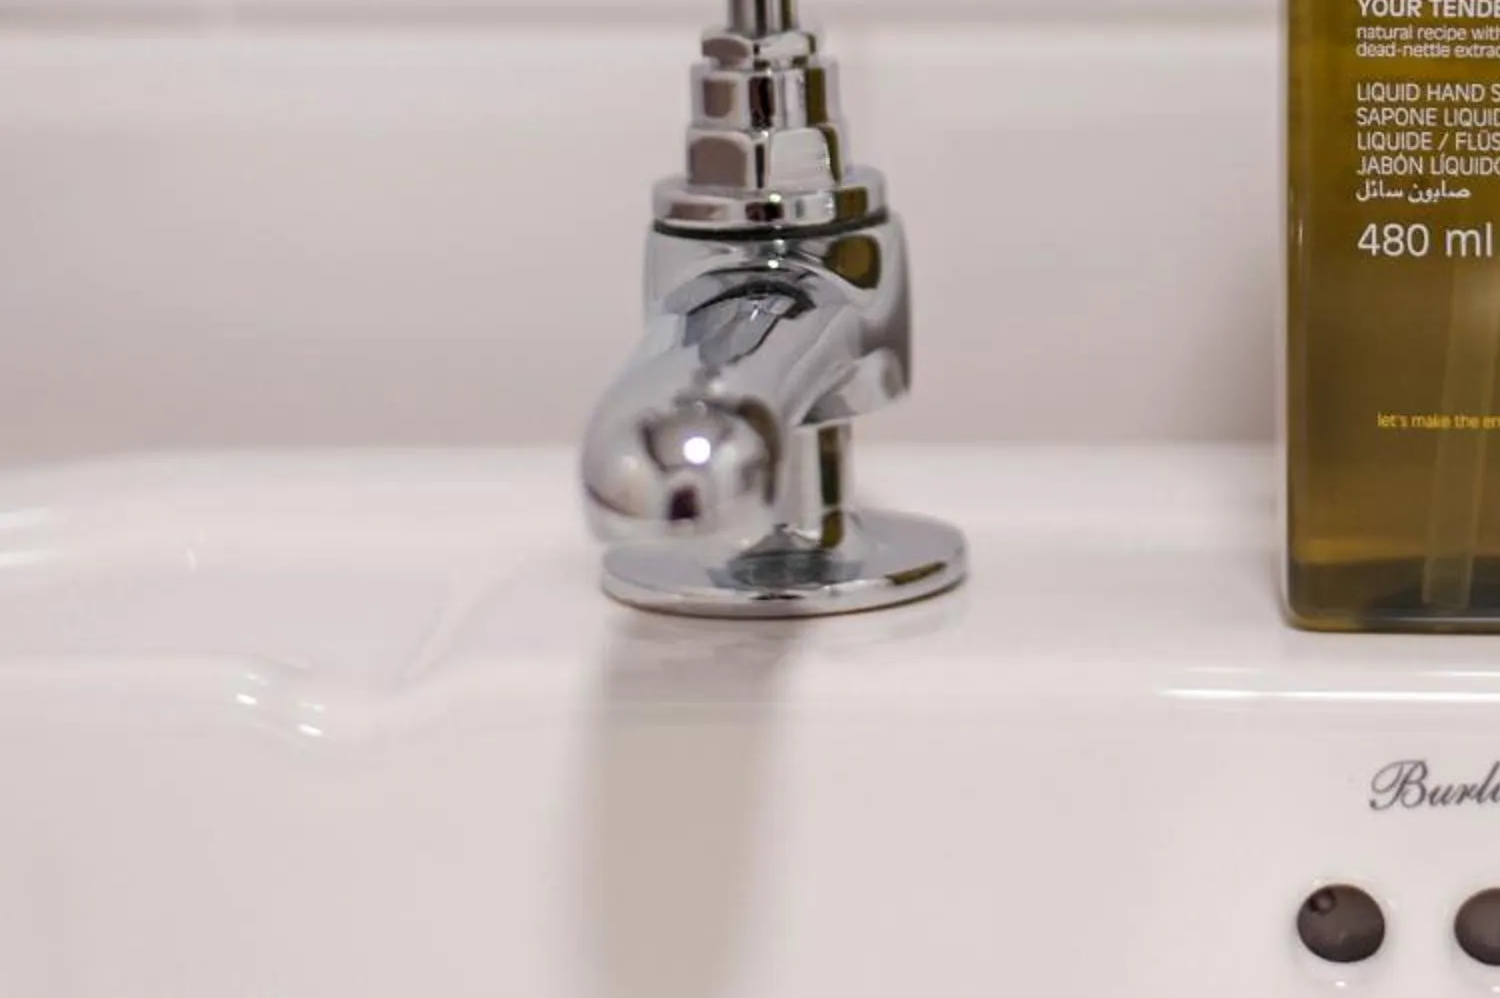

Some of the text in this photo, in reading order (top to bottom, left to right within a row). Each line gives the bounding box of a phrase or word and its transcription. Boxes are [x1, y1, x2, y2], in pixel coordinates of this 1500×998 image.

[1356, 24, 1413, 40] natural
[1416, 26, 1467, 44] recipe
[1356, 42, 1450, 57] dead-nettle
[1357, 84, 1420, 103] LIQUID
[1427, 84, 1485, 102] HAND
[1356, 108, 1437, 127] SAPONE
[1357, 132, 1432, 153] LIQUIDE
[1438, 132, 1450, 152] /
[1407, 179, 1471, 203] صابون
[1357, 222, 1430, 257] 480
[1445, 221, 1493, 257] ml
[1411, 412, 1450, 429] make
[1454, 413, 1479, 429] the
